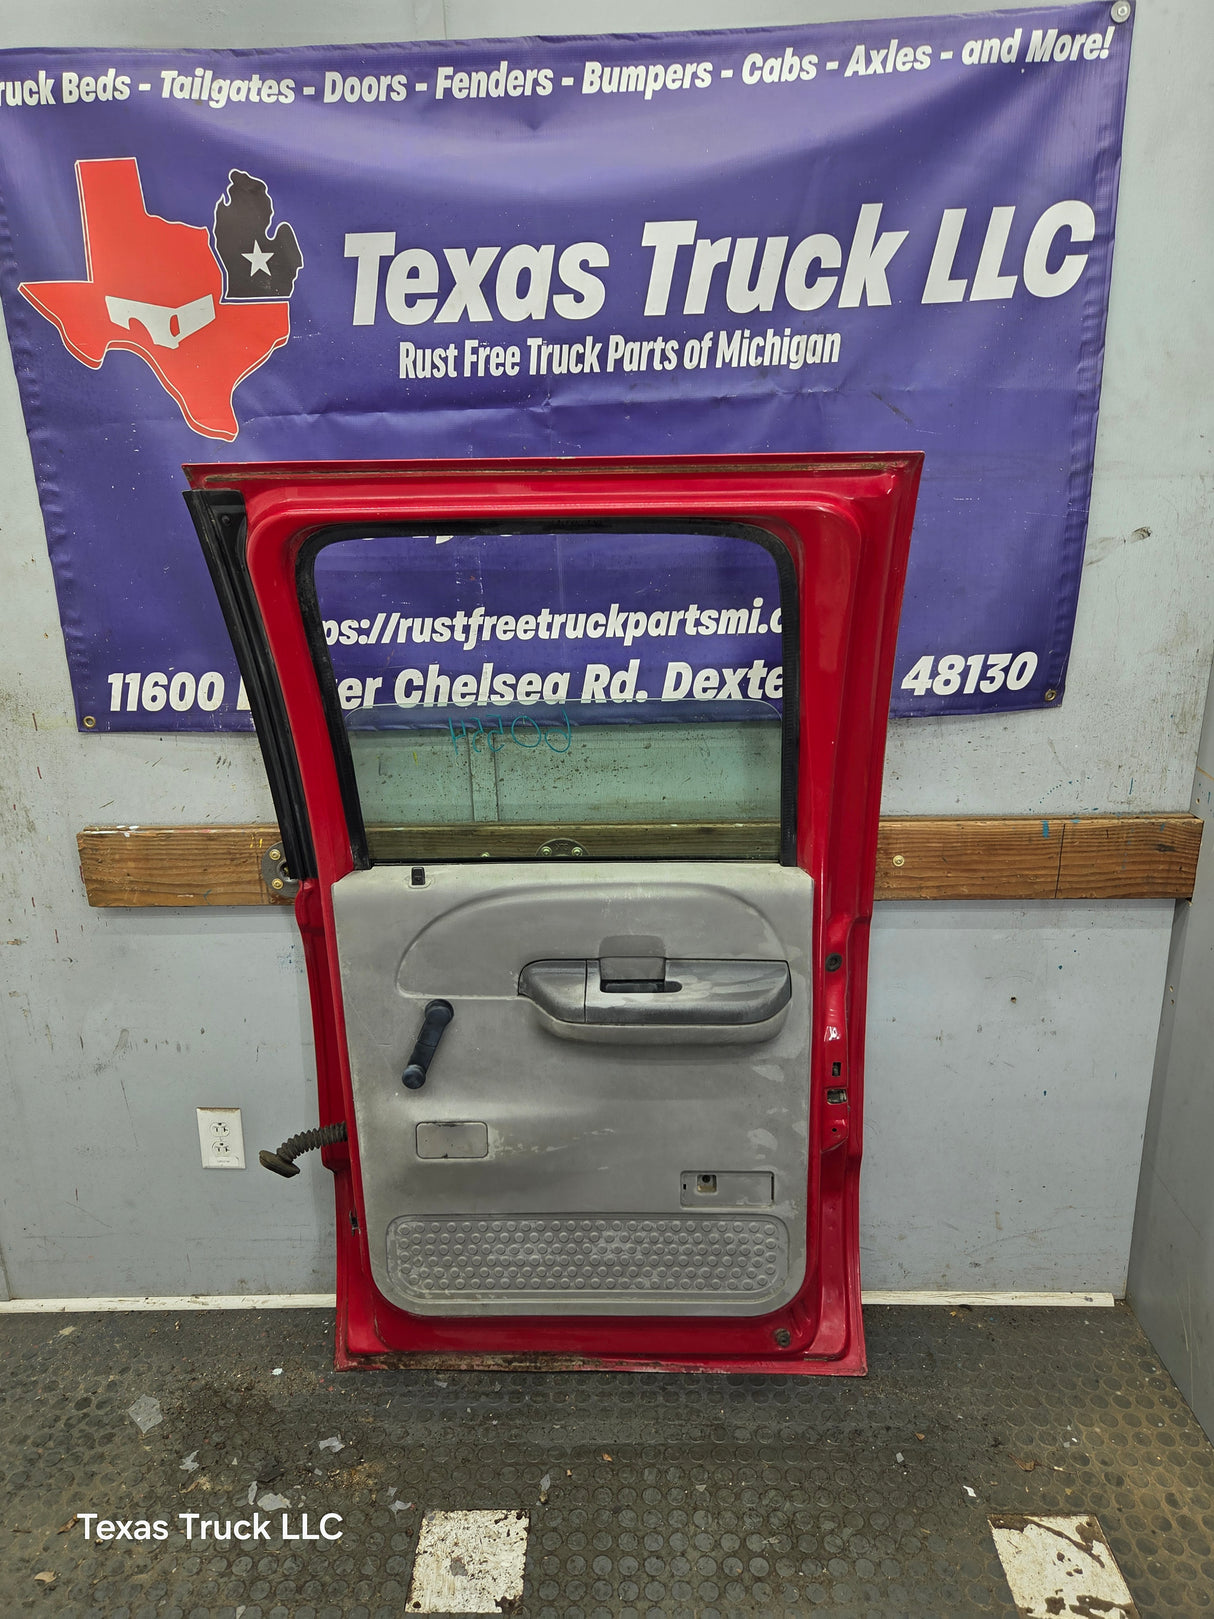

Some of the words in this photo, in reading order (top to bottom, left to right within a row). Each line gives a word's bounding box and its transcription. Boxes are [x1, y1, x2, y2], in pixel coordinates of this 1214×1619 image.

[0, 69, 57, 107] ruck
[62, 68, 132, 104] Beds
[160, 66, 296, 109] Tailgates
[322, 70, 408, 104] Doors
[435, 60, 553, 101] Fenders
[581, 58, 713, 101] Bumpers
[741, 47, 818, 84] Cabs
[844, 38, 931, 78] Axles
[961, 28, 1022, 66] and
[1025, 24, 1112, 64] More!
[343, 231, 612, 326] Texas
[641, 202, 910, 318] Truck
[921, 199, 1096, 305] LLC
[398, 341, 459, 380] Rust
[463, 338, 520, 378] Free
[526, 335, 603, 375] Truck
[606, 334, 684, 373] Parts
[683, 330, 713, 371] of
[715, 328, 843, 374] Michigan
[321, 597, 784, 651] ps://rustfreetruckpartsmi.c
[107, 671, 225, 712] 11600
[393, 661, 571, 708] Chelsea
[584, 658, 649, 702] Rd.
[661, 659, 784, 704] Dexte
[900, 651, 1038, 696] 48130
